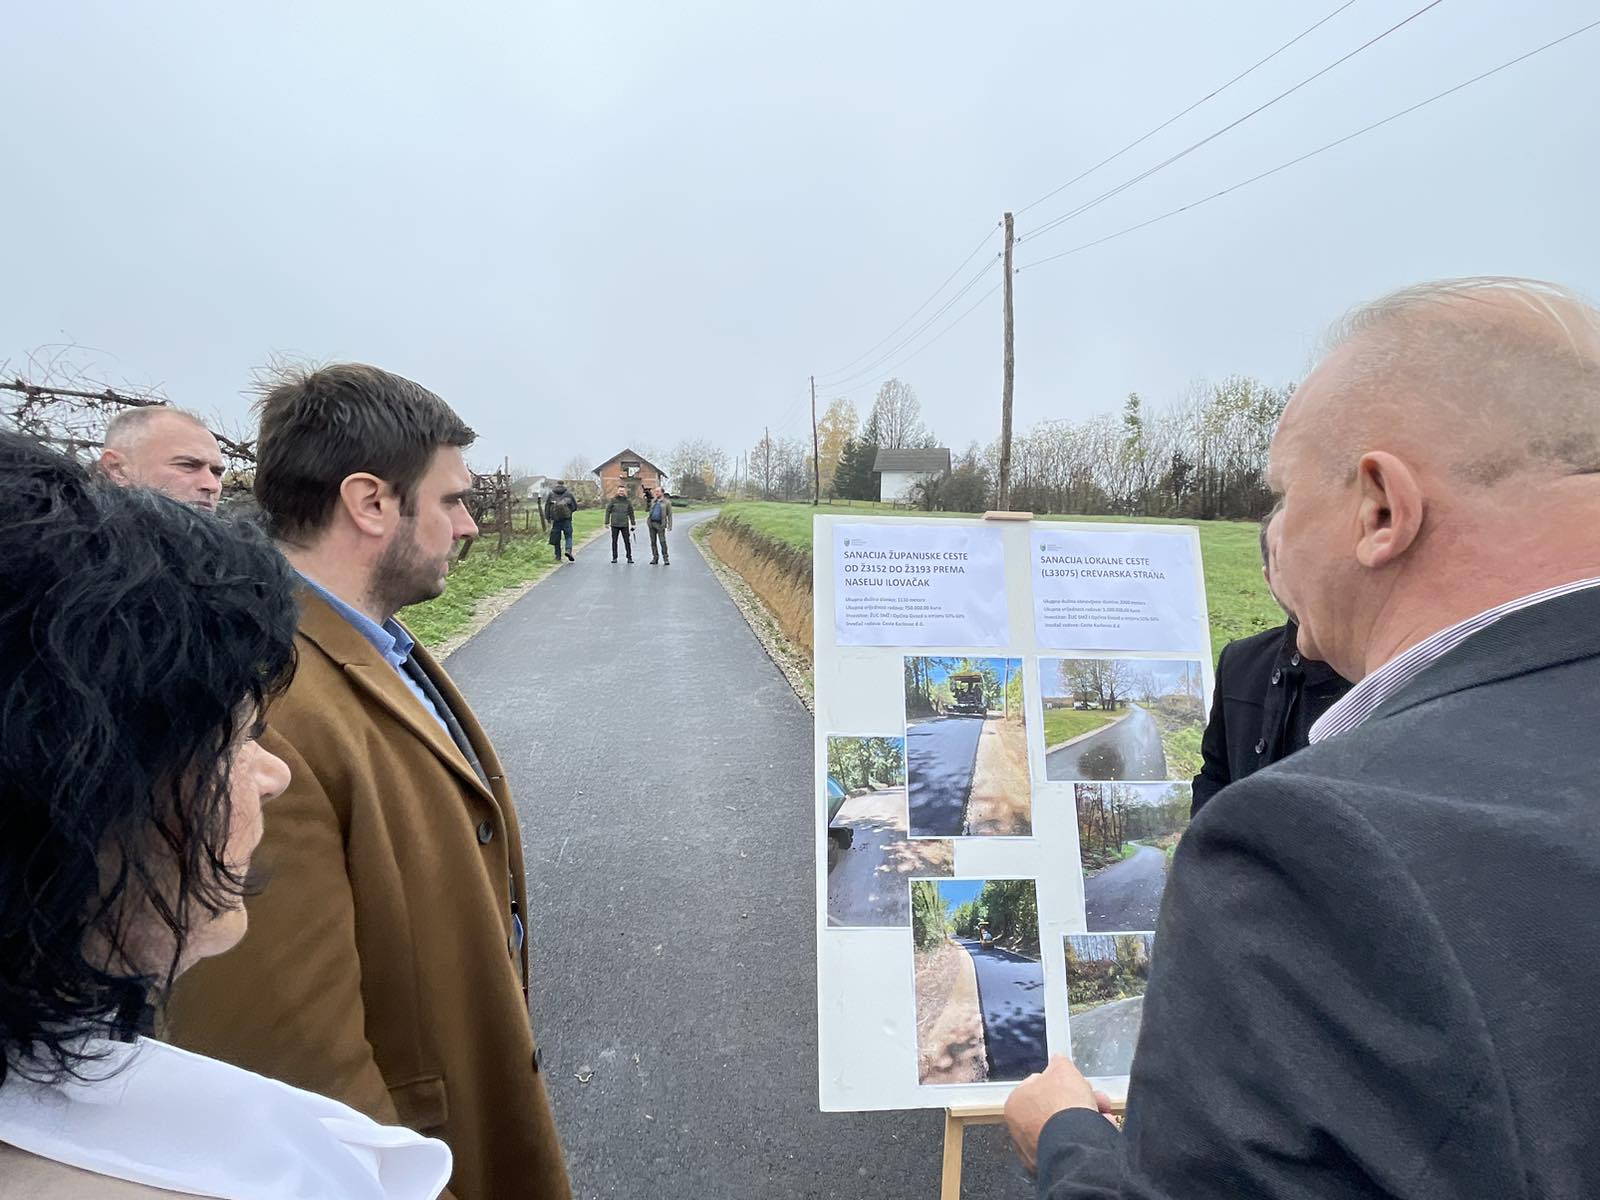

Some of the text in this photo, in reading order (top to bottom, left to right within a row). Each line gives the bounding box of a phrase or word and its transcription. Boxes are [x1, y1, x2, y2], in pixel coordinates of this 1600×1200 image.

[844, 549, 968, 561] SANACIJA ŽUPANIJSKE CESTE
[1040, 556, 1150, 566] SANACIJA LOKALNE CESTE
[844, 563, 965, 574] OD Ž3152 DO Ž3193 PREMA
[1041, 569, 1166, 580] (L33075) CREVARSKA STRANA
[845, 577, 930, 587] NASELJU ILOVAČAK
